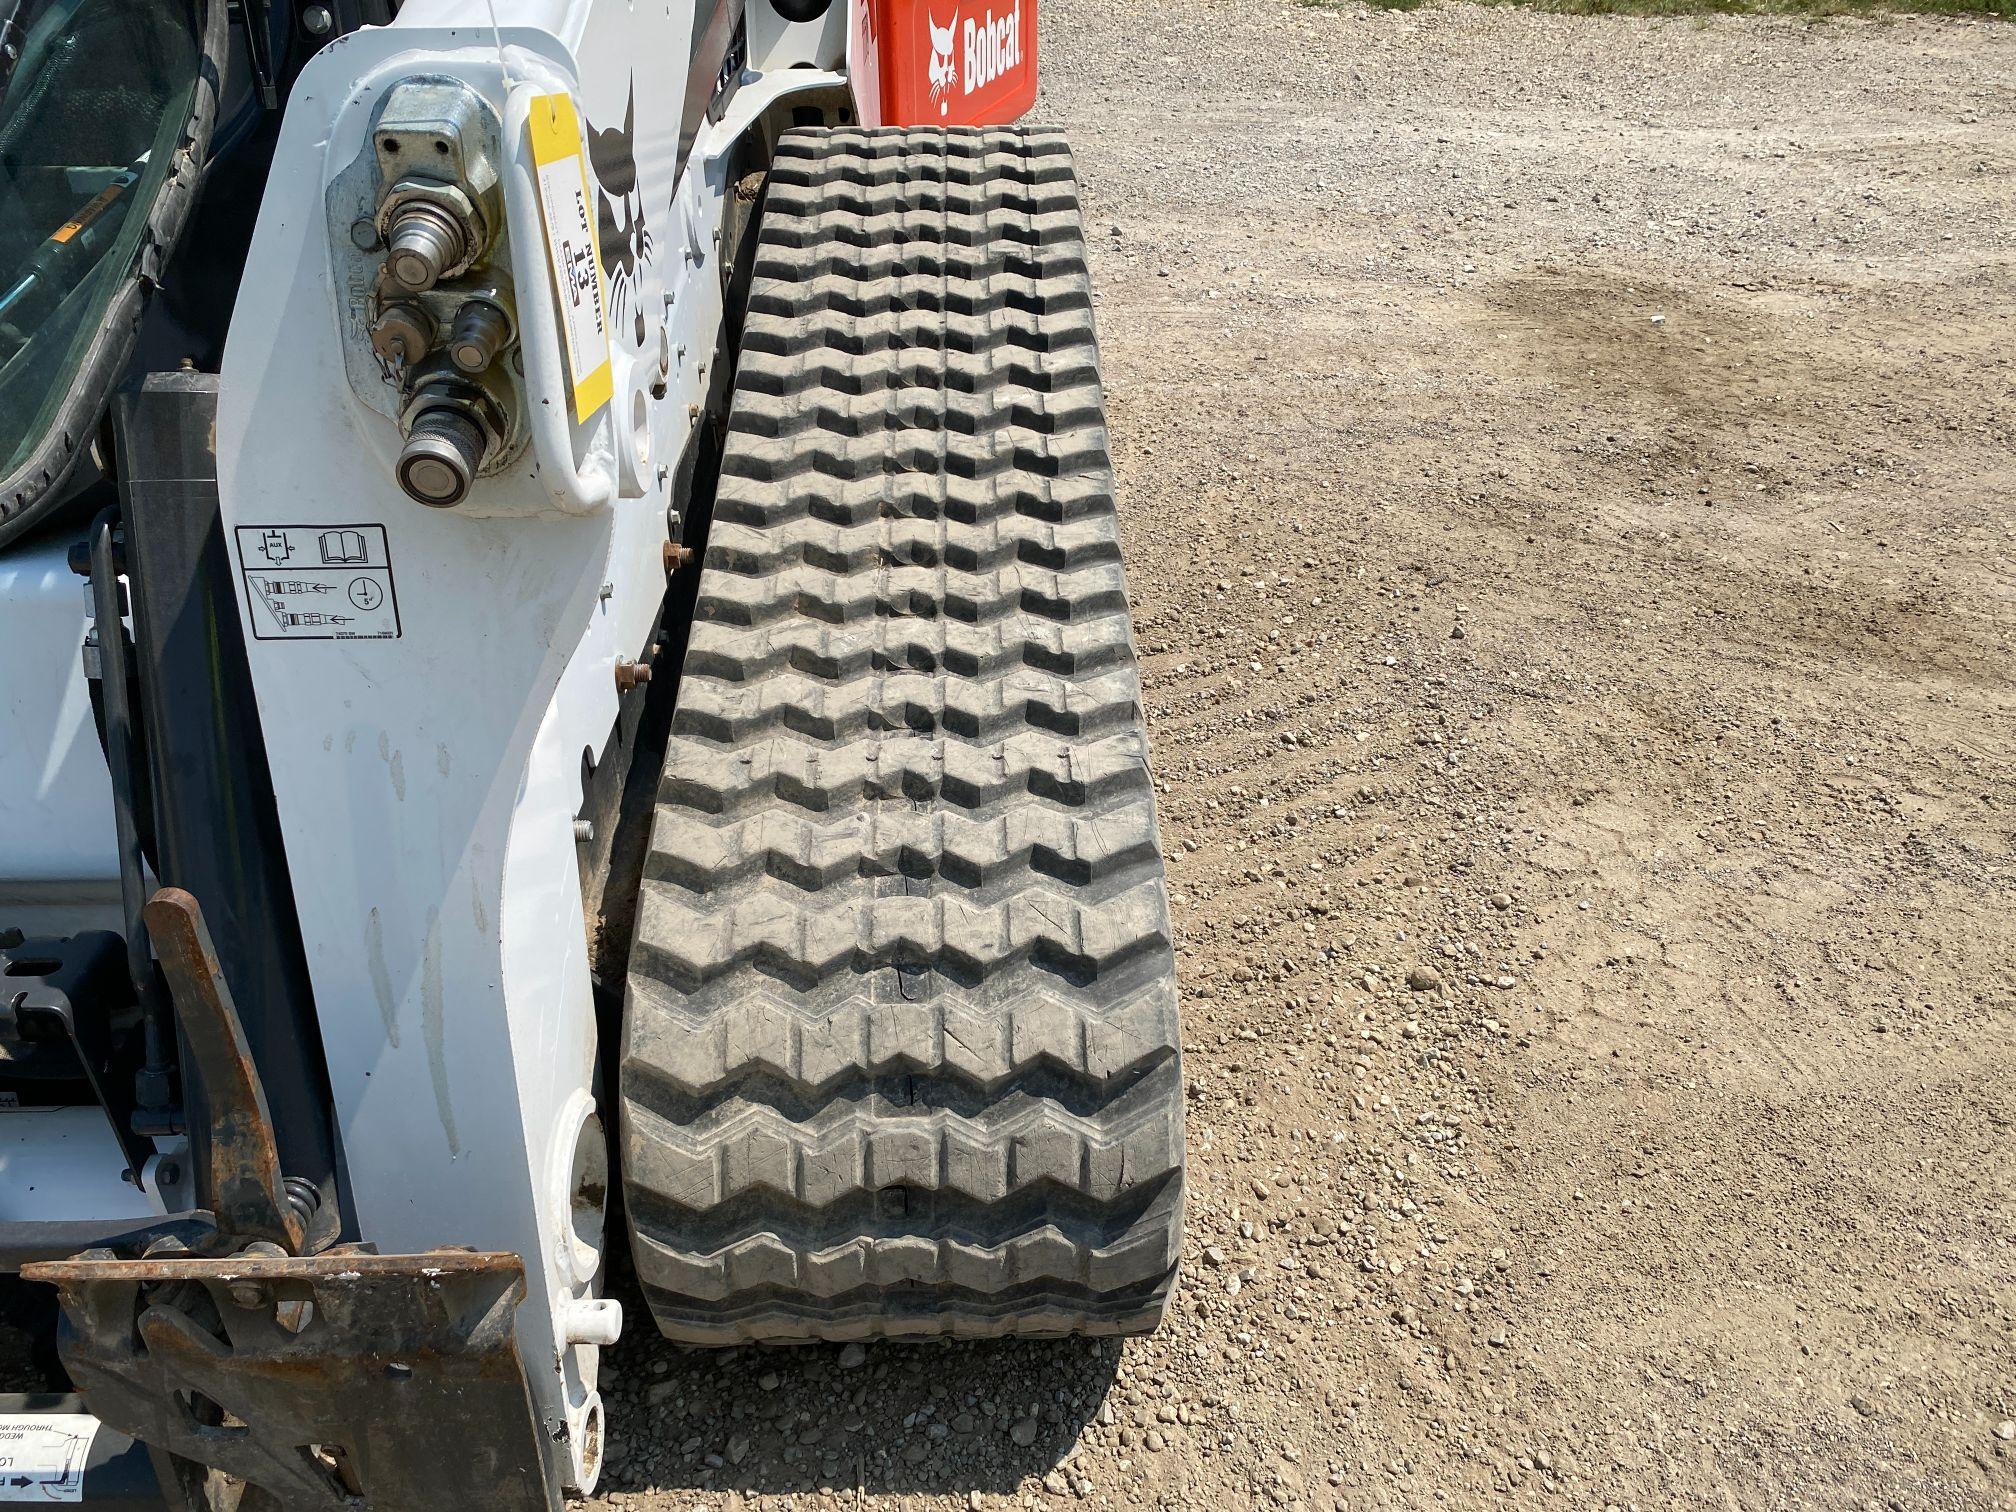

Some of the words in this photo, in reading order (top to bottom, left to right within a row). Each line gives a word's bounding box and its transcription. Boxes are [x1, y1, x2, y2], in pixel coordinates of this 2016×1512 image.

[964, 0, 1020, 95] Bobcat
[573, 248, 590, 290] 13
[575, 190, 589, 233] LOT
[585, 242, 603, 336] NUMBER
[11, 1424, 53, 1432] THROUGH
